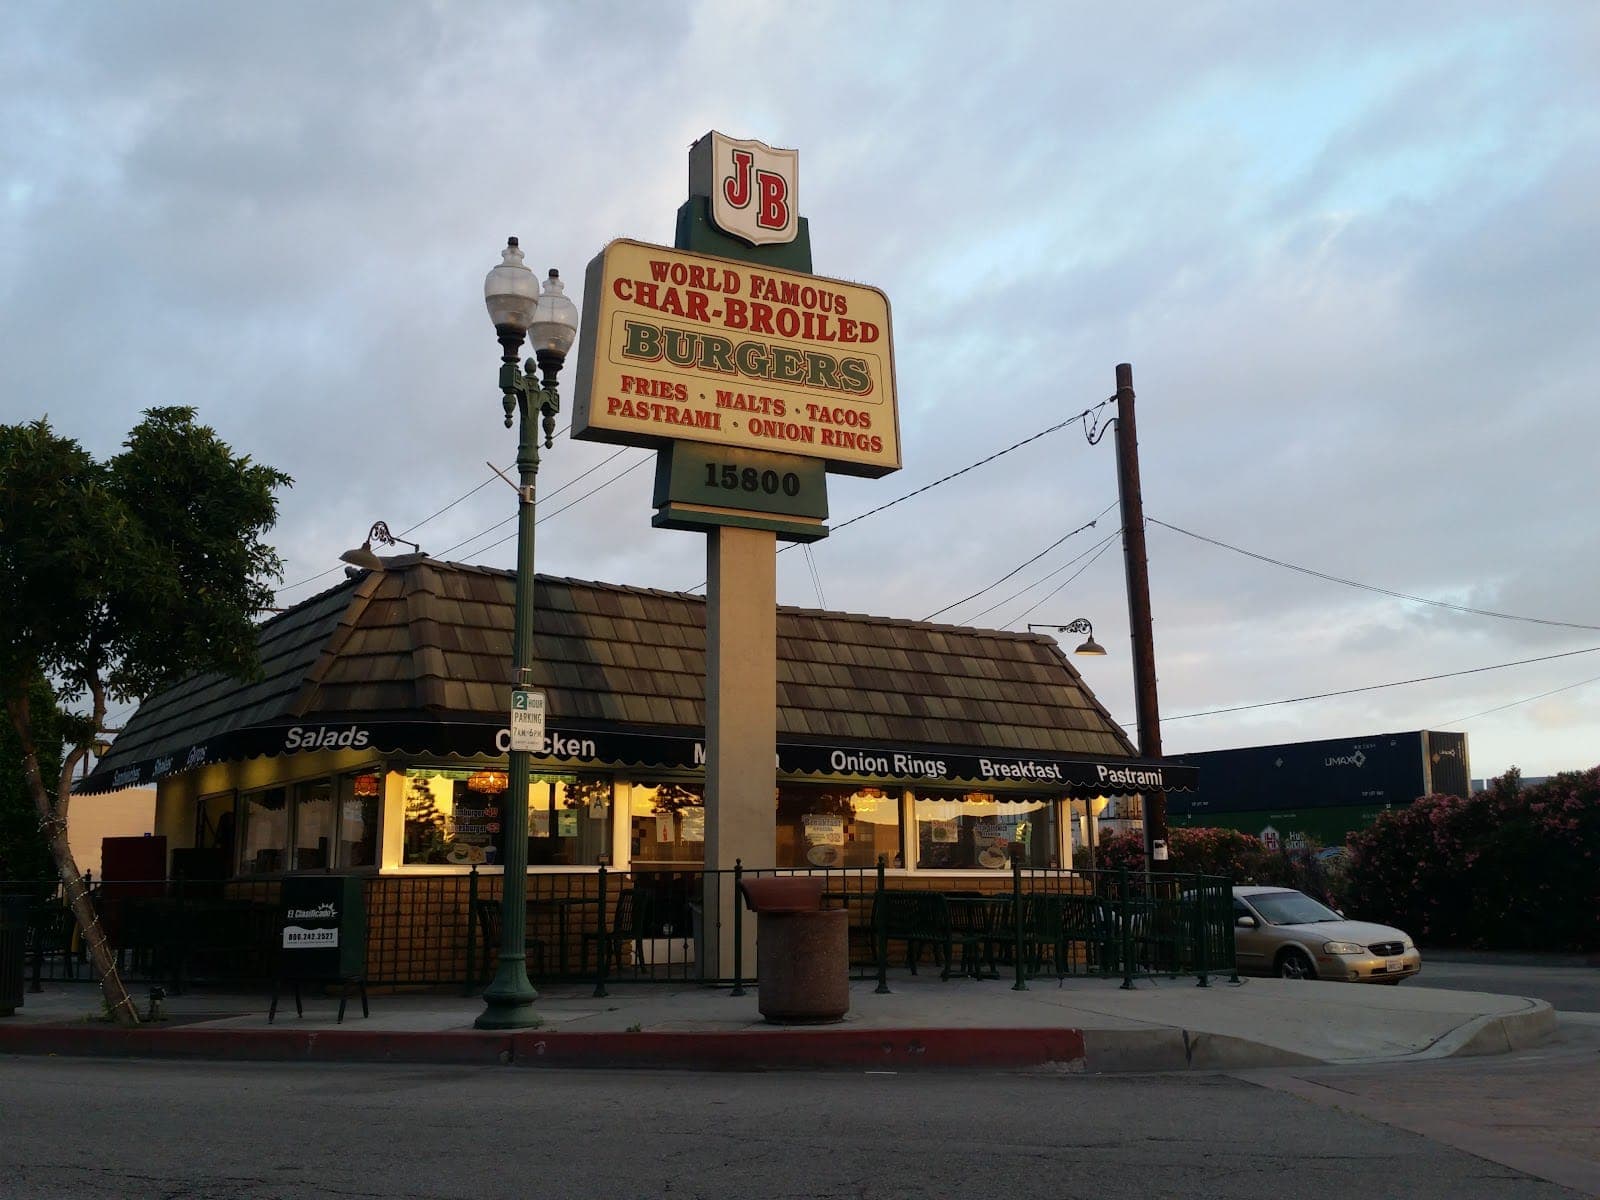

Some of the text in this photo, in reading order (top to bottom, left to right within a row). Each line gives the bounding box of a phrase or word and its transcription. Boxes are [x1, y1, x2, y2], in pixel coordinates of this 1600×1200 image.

[649, 260, 848, 316] WORLD FAMOUS
[613, 277, 880, 343] CHAR-BROILED
[622, 319, 873, 396] BURGERS
[620, 374, 872, 429] FRIES MALTS TACOS
[606, 396, 883, 454] PASTRAMI ONION RINGS
[704, 462, 801, 497] 15800
[516, 695, 543, 708] 2 HOUR
[514, 711, 542, 724] PARKING
[285, 725, 370, 749] Salads
[495, 728, 596, 757] Ccken
[830, 750, 948, 778] Onion Rings
[980, 758, 1063, 780] Breakfast
[1324, 754, 1354, 767] UMAX
[1096, 764, 1164, 786] Pastrami
